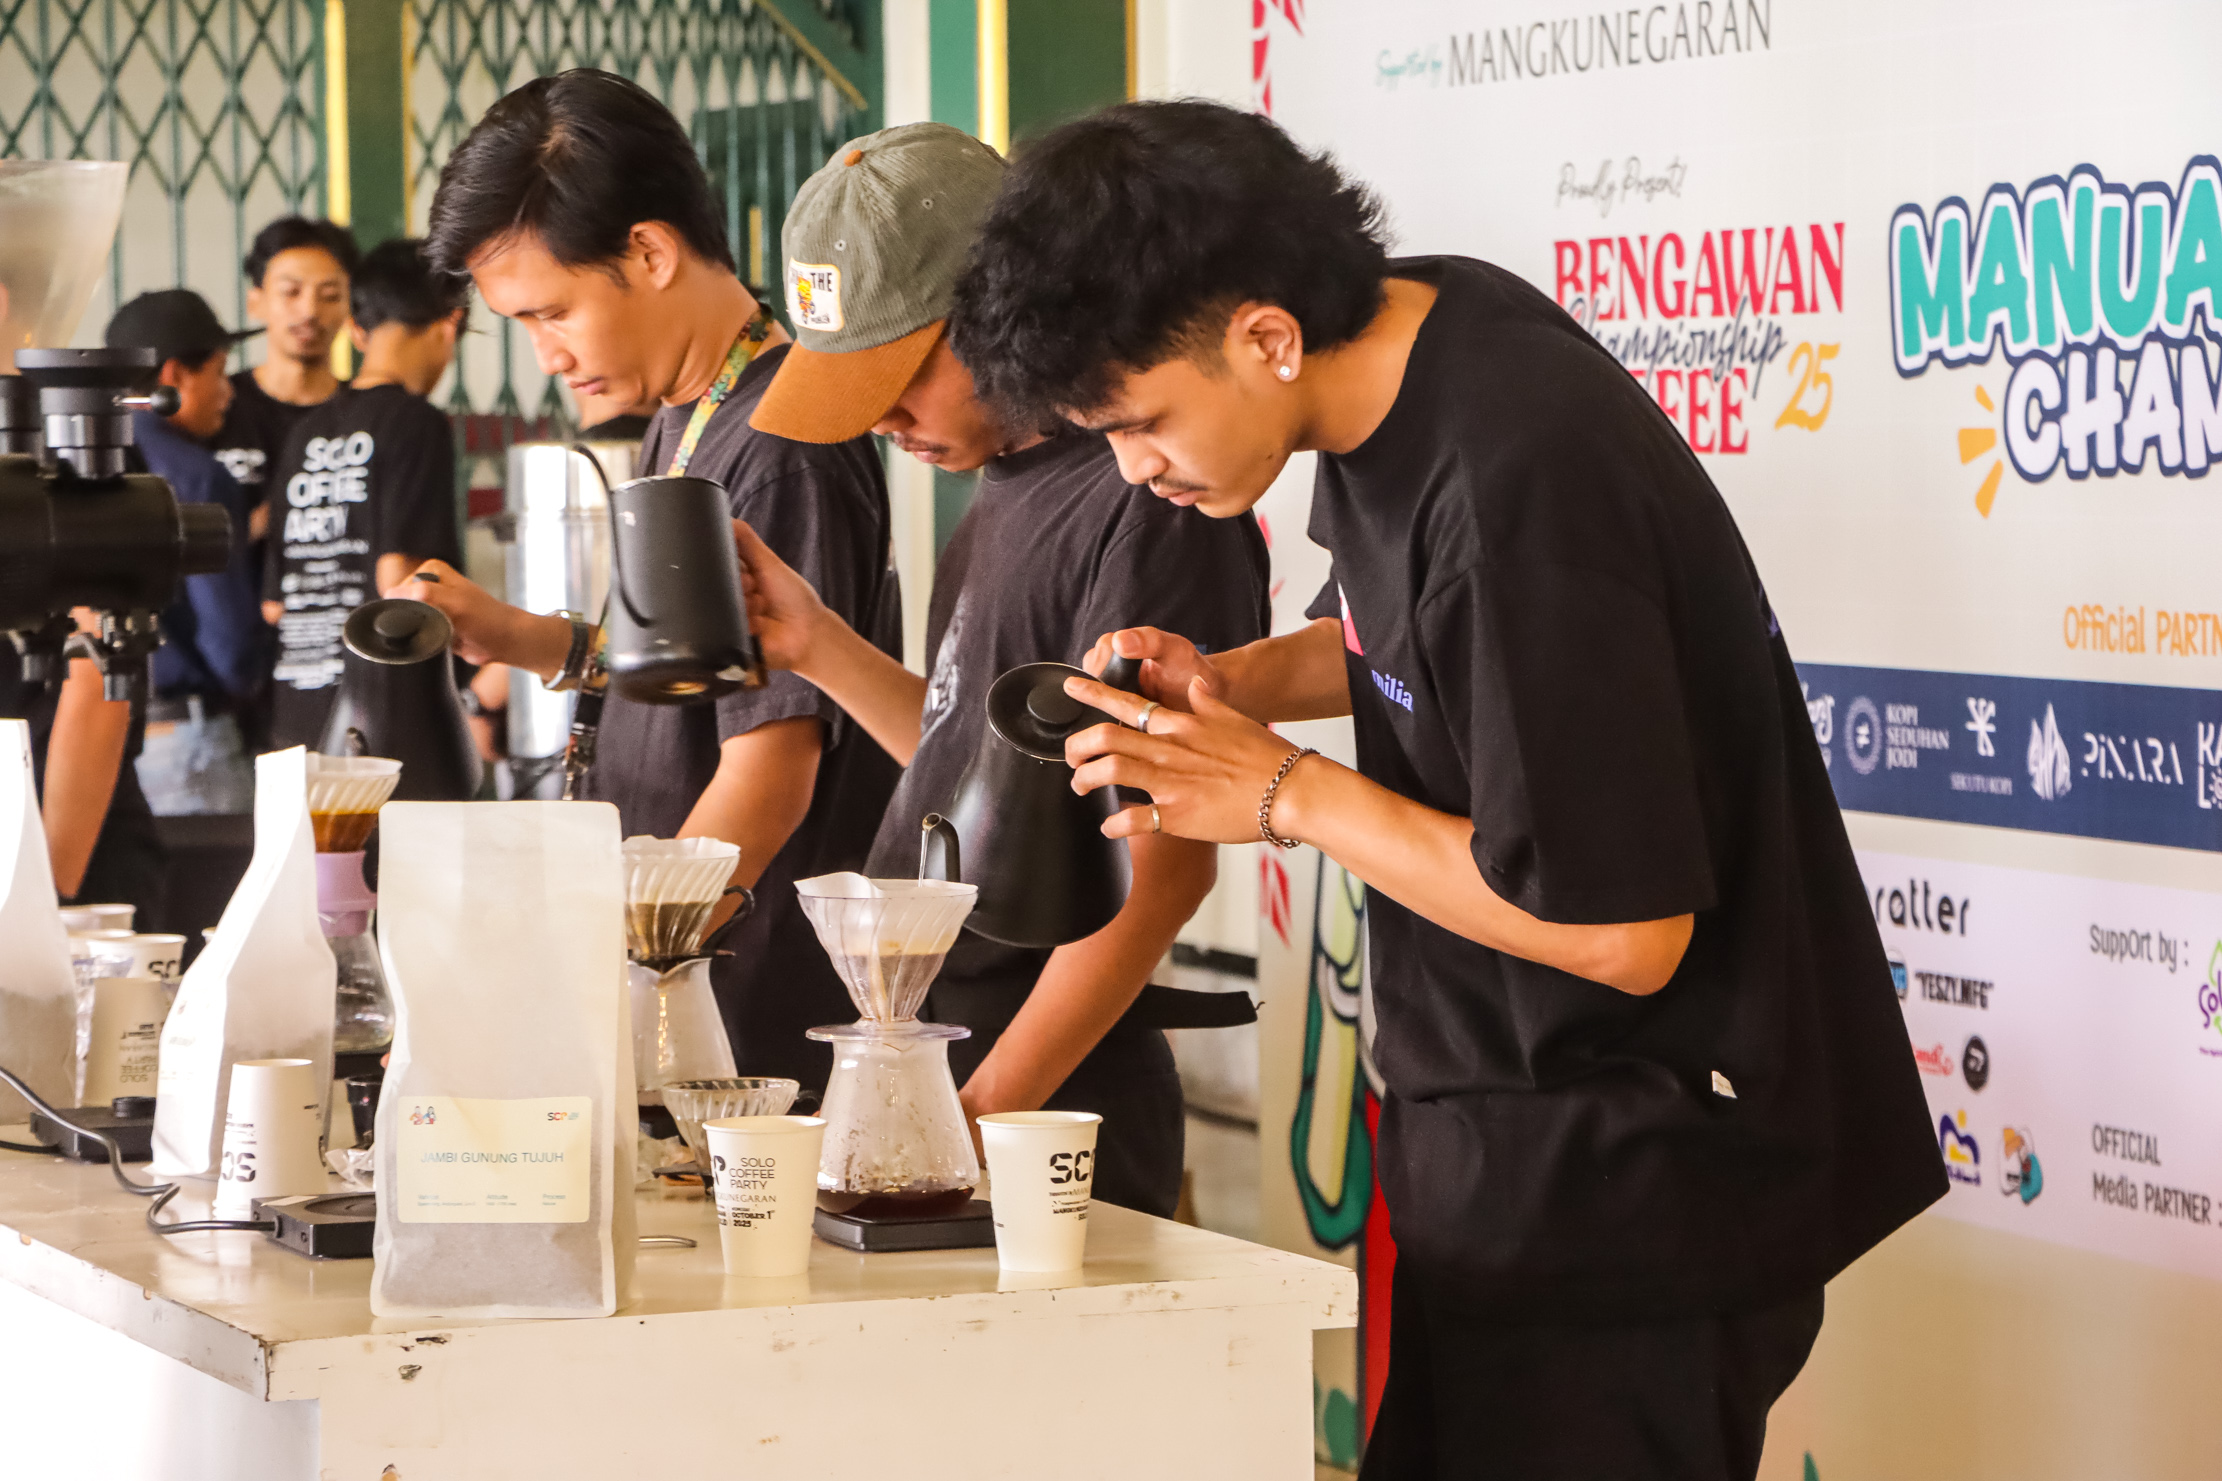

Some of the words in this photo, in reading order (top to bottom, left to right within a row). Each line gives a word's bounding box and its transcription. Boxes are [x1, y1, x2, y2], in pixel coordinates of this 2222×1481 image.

[1448, 0, 1773, 88] MANGKUNEGARAN
[809, 271, 833, 293] THE
[1554, 222, 1846, 323] BENGAWAN
[1773, 340, 1842, 433] 25
[1627, 365, 1749, 455] FEE
[2063, 604, 2146, 654] Official
[1371, 668, 1414, 713] milia
[1885, 703, 1919, 727] KOPI
[1885, 725, 1951, 751] SEDUHAN
[1863, 877, 1970, 937] ratter
[2159, 931, 2177, 974] by
[421, 1152, 457, 1163] JAMBI
[461, 1152, 518, 1163] GUNUNG
[521, 1152, 564, 1163] TUJUH
[740, 1157, 776, 1168] SOLO
[2092, 1123, 2162, 1167] OFFICIAL
[729, 1168, 775, 1179] COFFEE
[730, 1180, 767, 1190] PARTY
[731, 1212, 766, 1220] OCTOBER
[2093, 1171, 2138, 1211] Media
[2144, 1182, 2212, 1225] PARTNER
[733, 1219, 752, 1227] 2025
